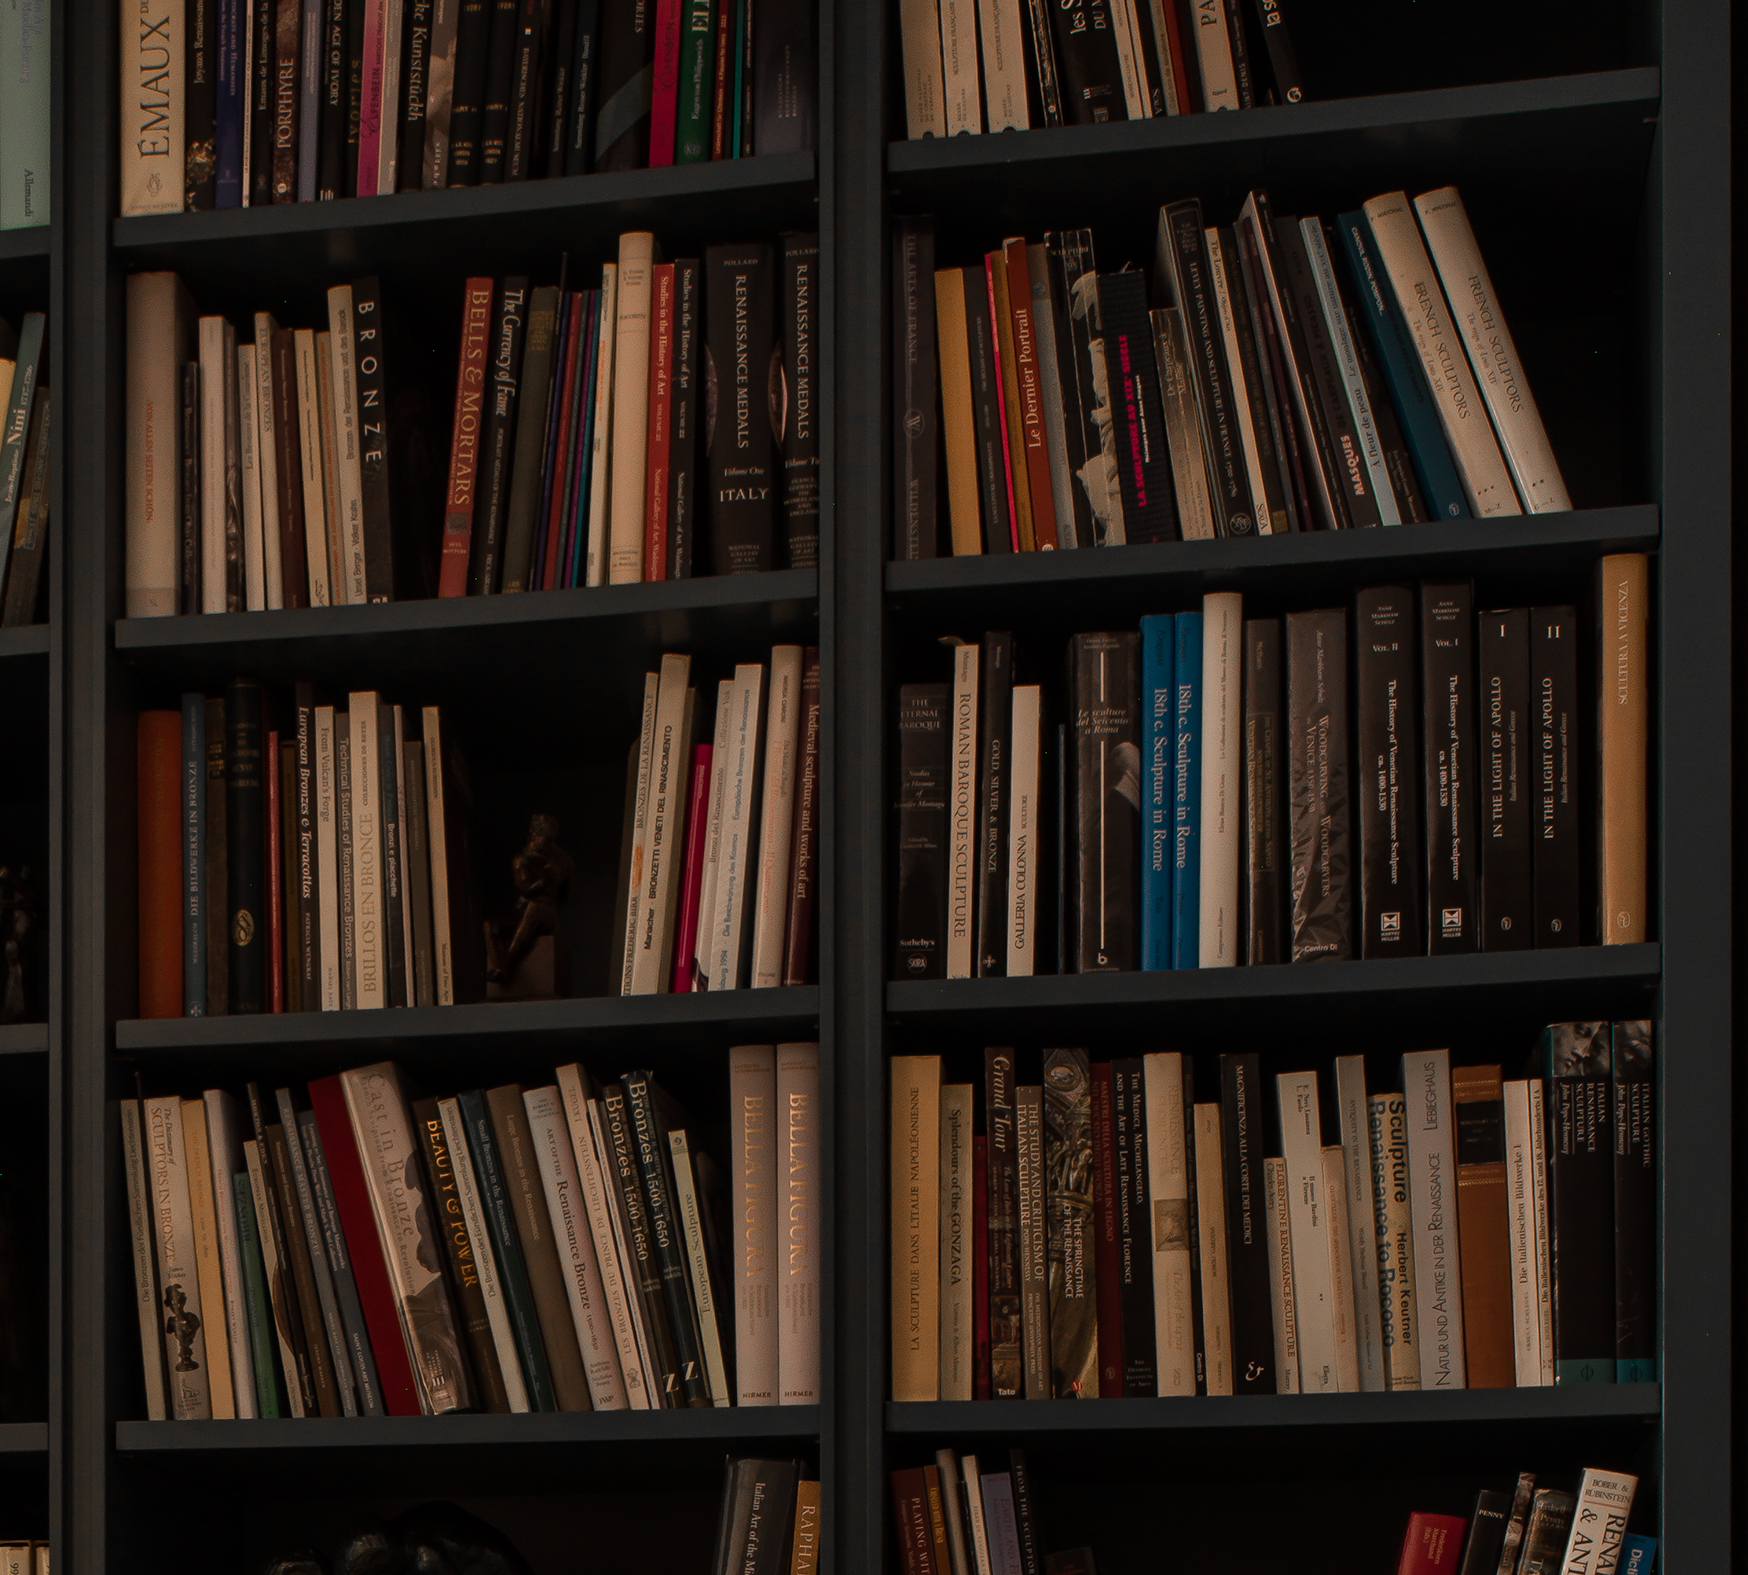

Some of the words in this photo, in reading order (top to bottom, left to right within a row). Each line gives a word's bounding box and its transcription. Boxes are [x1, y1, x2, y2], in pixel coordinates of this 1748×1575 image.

[137, 16, 170, 157] ÉMAUX
[276, 57, 294, 148] PORPHYRE
[23, 169, 34, 217] Allemandi
[466, 290, 489, 359] BELLS
[735, 275, 747, 384] RENAISSANCE
[1015, 308, 1032, 362] Portrait
[356, 301, 382, 463] BRONZE
[464, 366, 482, 385] &
[1021, 367, 1039, 424] Dernier
[736, 387, 748, 448] MEDALS
[1027, 429, 1042, 447] Le
[453, 392, 480, 504] MORTARS
[718, 486, 769, 503] ITALY
[957, 693, 971, 756] ROMAN
[1153, 687, 1168, 716] 18th
[1153, 720, 1162, 733] c.
[1490, 676, 1501, 727] APOLLO
[296, 706, 309, 765] European
[1491, 730, 1501, 747] OF
[299, 768, 310, 815] Bronzes
[1150, 737, 1167, 805] Sculpture
[1492, 751, 1502, 790] LIGHT
[953, 759, 970, 841] BAROQUE
[1152, 809, 1166, 824] in
[1492, 794, 1502, 820] THE
[1151, 829, 1166, 871] Rome
[1492, 822, 1502, 836] IN
[300, 830, 312, 898] Terracottas
[1015, 833, 1027, 890] COLONNA
[953, 844, 967, 939] SCULPTURE
[1013, 893, 1026, 949] GALLERIA
[992, 1056, 1011, 1110] Grand
[1422, 1061, 1438, 1130] LIEBIEGHAUS
[426, 1119, 457, 1192] BEAUTY
[743, 1096, 764, 1176] BELLA
[993, 1114, 1011, 1152] Tour
[1387, 1101, 1407, 1203] Sculpture
[627, 1079, 659, 1164] Bronzes
[645, 1170, 670, 1248] 1500-1650
[444, 1197, 460, 1215] &
[684, 1193, 701, 1251] Sculpture
[744, 1182, 765, 1277] FIGURA
[449, 1221, 479, 1287] POWER
[1397, 1232, 1408, 1283] Herbert
[694, 1254, 711, 1313] European
[1400, 1289, 1411, 1345] Keutner
[748, 1513, 761, 1528] Art
[750, 1482, 766, 1510] Italian
[1578, 1508, 1599, 1523] &
[745, 1544, 757, 1557] the
[747, 1530, 760, 1542] of
